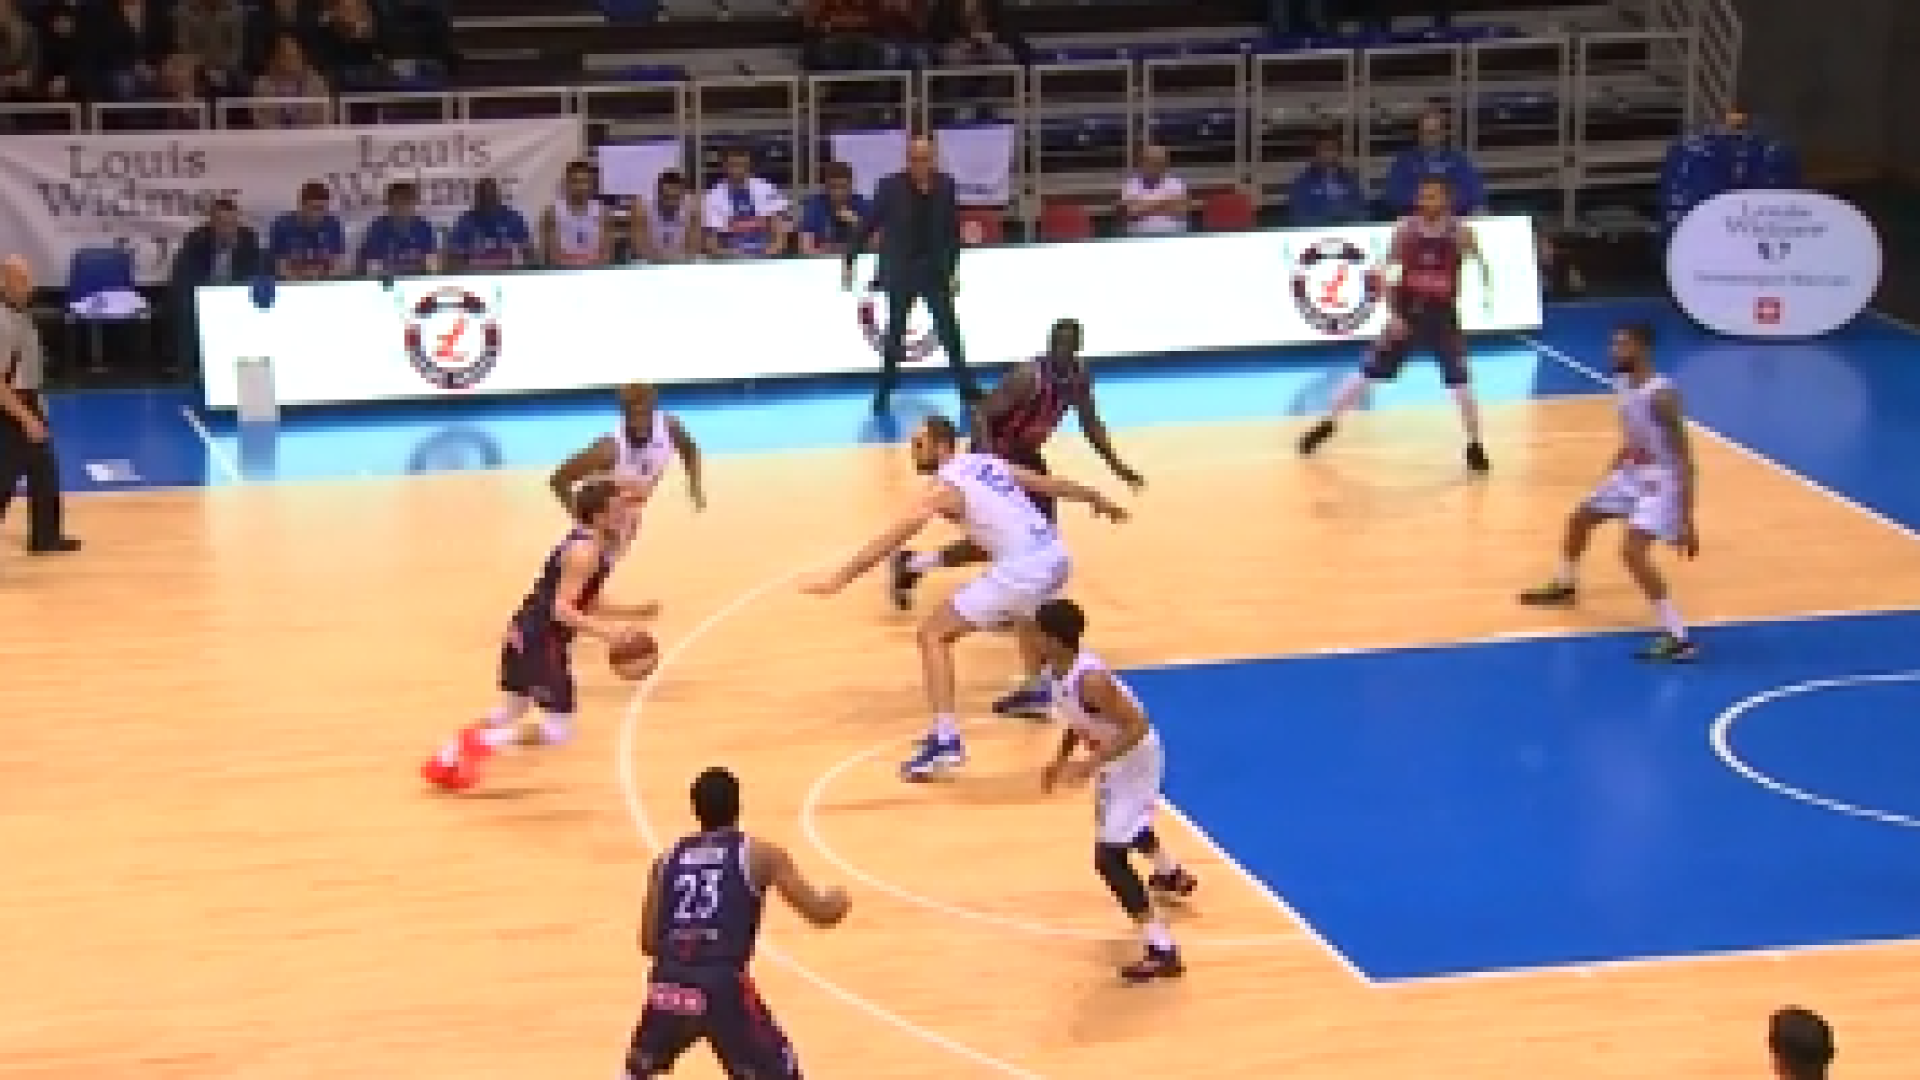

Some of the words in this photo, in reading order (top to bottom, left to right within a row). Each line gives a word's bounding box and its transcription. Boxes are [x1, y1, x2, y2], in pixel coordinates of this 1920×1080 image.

[66, 141, 208, 179] Louis
[358, 134, 491, 169] Louis
[673, 868, 724, 920] 23
